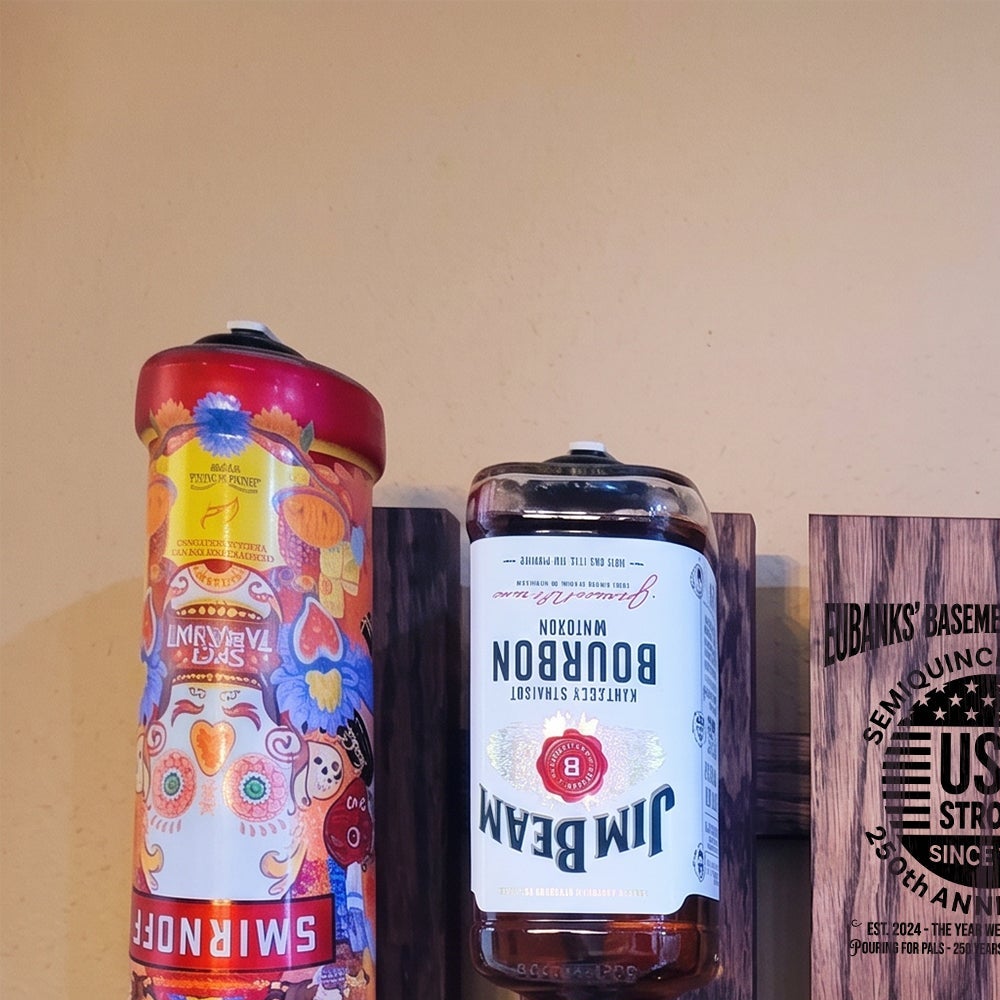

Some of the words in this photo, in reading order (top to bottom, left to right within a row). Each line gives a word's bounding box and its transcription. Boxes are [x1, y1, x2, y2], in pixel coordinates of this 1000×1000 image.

[824, 602, 920, 667] EUBANKS'
[493, 640, 656, 685] BOURBON
[865, 826, 929, 898] 250th
[929, 845, 994, 867] SINCE
[132, 908, 317, 958] SMIRNOFF
[867, 922, 889, 936] EST.
[892, 923, 921, 936] 2024
[931, 923, 951, 937] THE
[954, 923, 981, 937] YEAR
[985, 923, 1000, 937] WE
[901, 942, 919, 954] FOR
[921, 942, 945, 954] PALS
